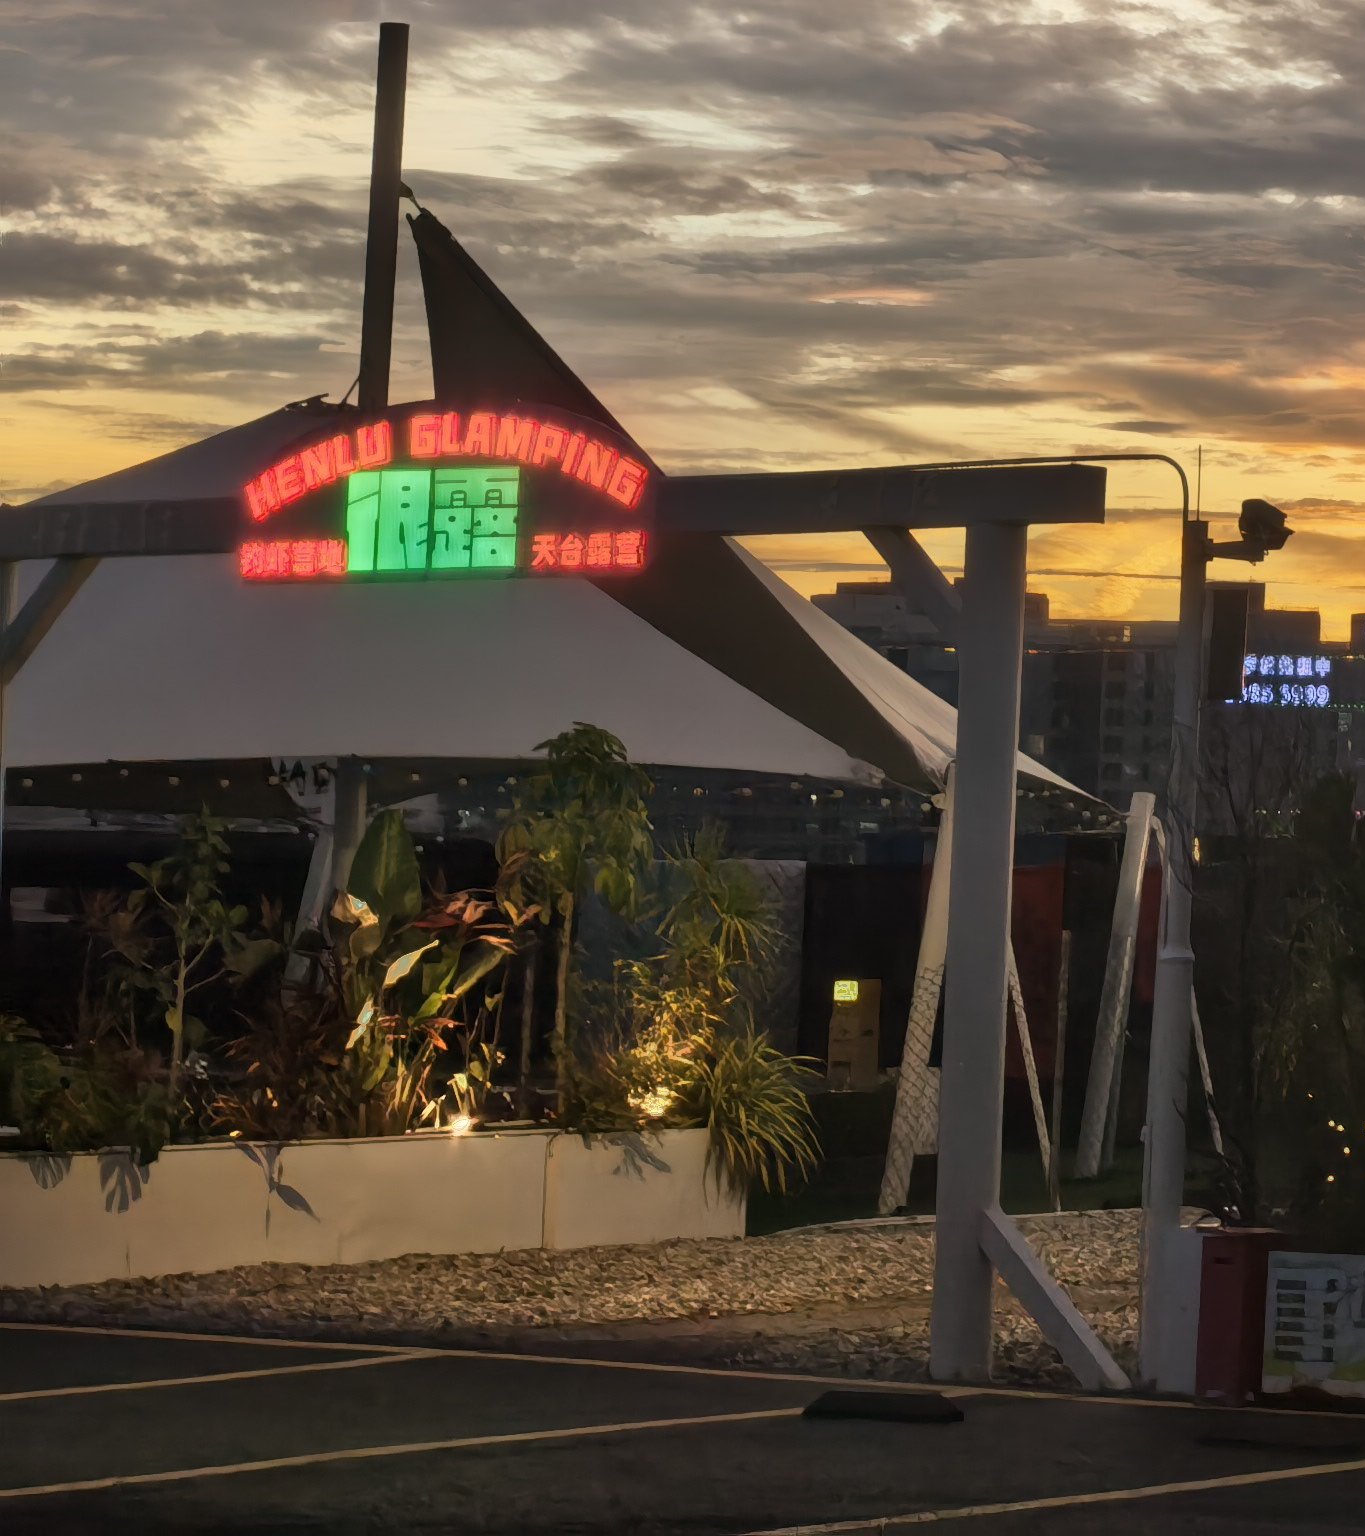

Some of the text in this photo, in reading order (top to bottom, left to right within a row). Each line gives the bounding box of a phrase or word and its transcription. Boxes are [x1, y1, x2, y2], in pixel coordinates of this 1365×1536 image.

[244, 412, 649, 522] HENLU GLAMPING
[531, 531, 645, 567] 天台露营
